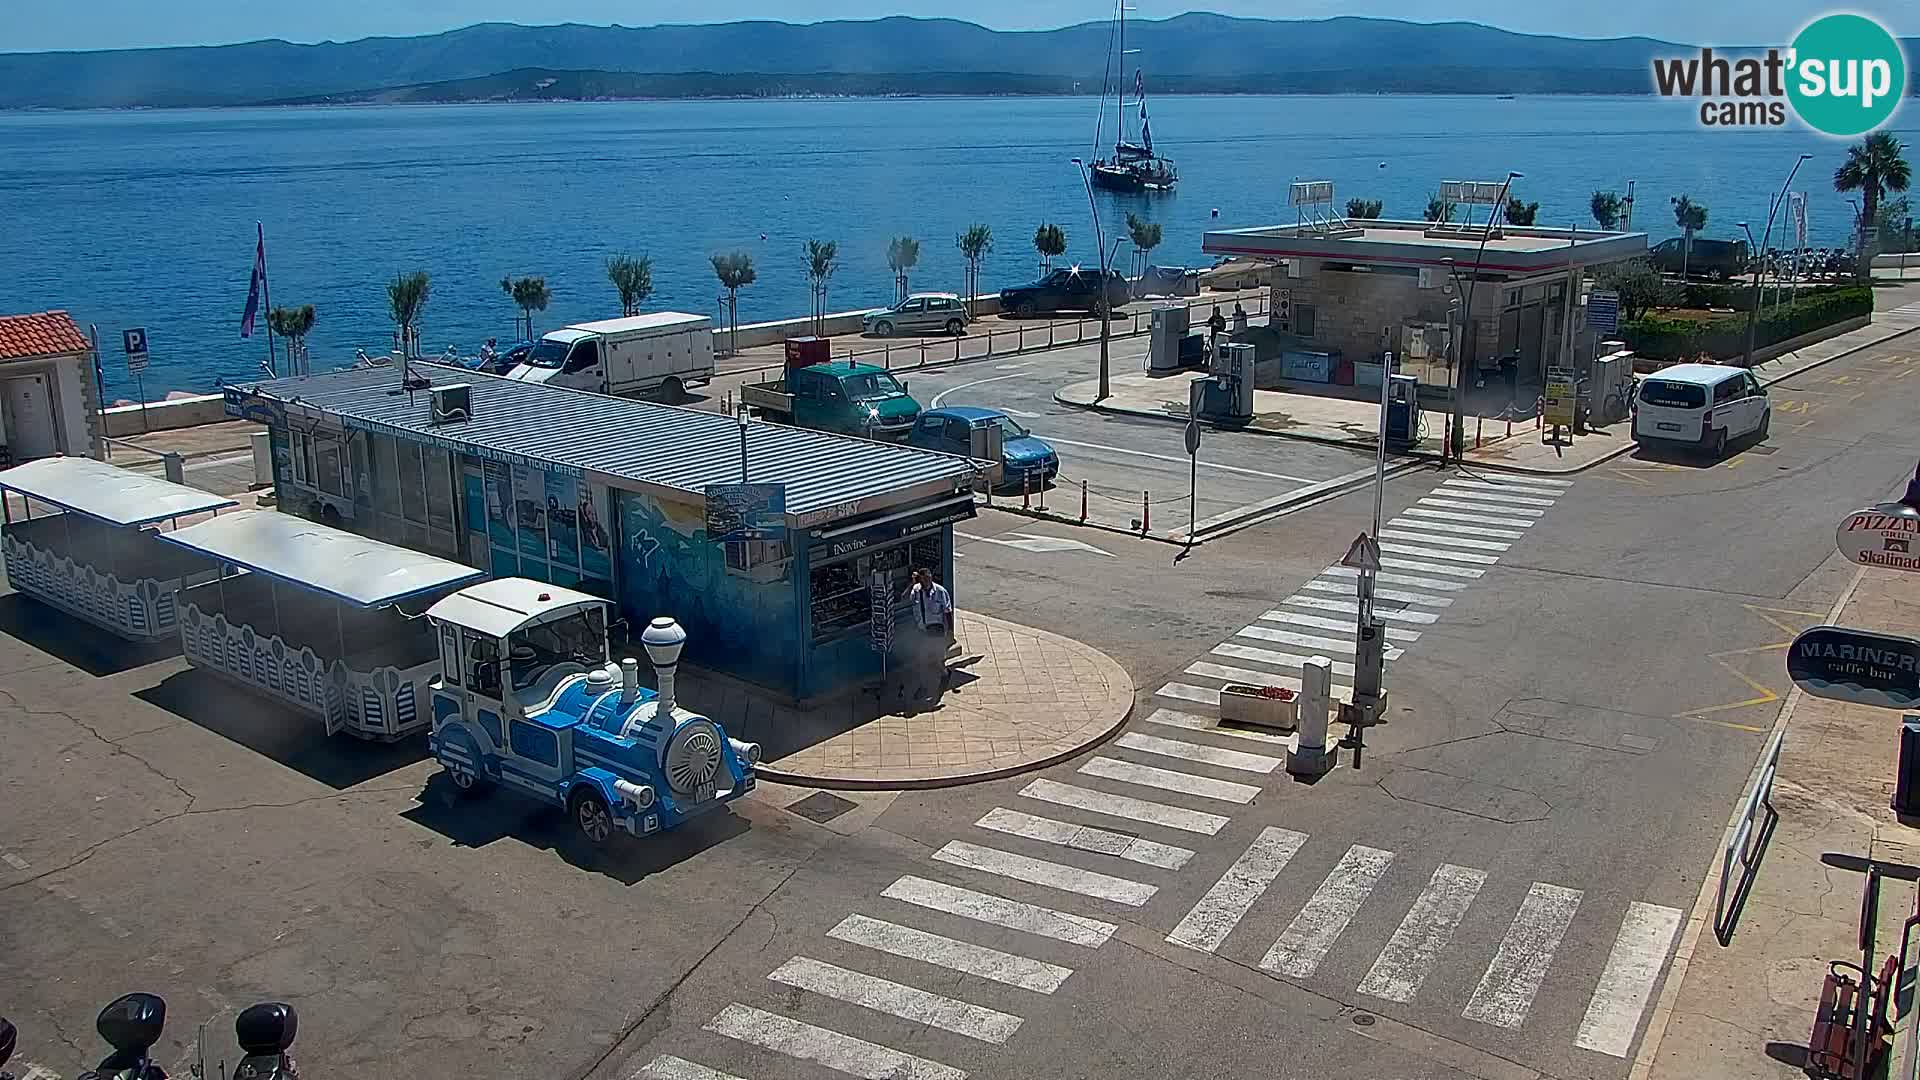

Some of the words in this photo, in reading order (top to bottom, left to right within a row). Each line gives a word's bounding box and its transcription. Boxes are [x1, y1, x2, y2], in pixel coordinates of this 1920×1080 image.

[128, 332, 141, 350] P
[1666, 383, 1684, 391] TAXI
[477, 446, 492, 458] BUS
[493, 450, 525, 465] STATION
[528, 457, 554, 472] TICKET
[554, 463, 581, 477] OFFICE
[1880, 530, 1916, 541] GRILL
[1870, 666, 1896, 680] bar
